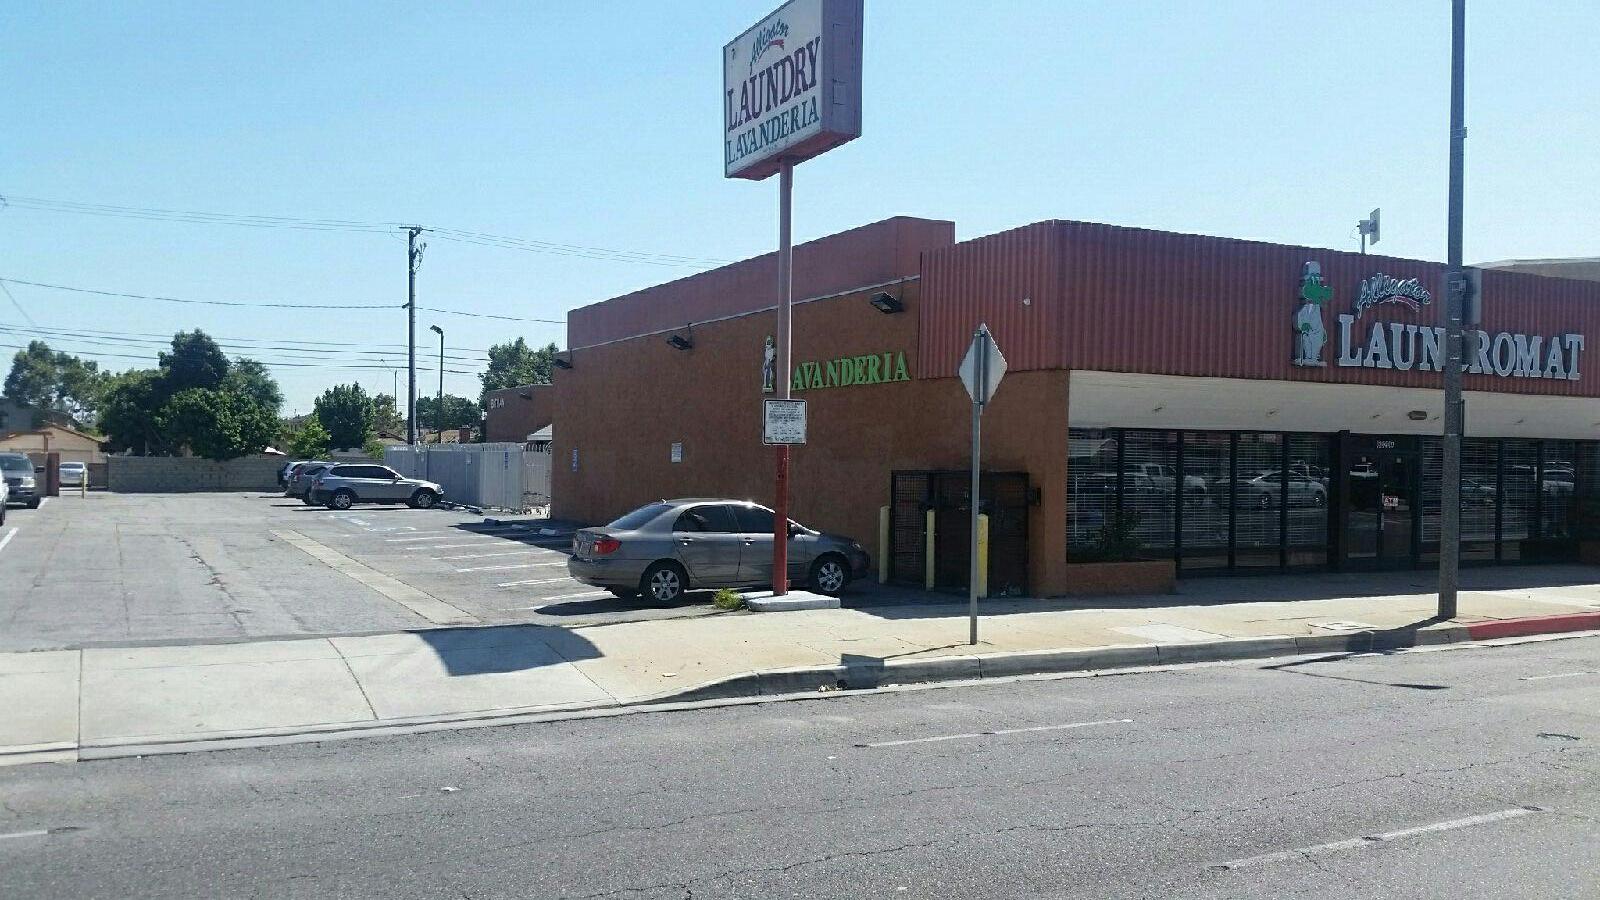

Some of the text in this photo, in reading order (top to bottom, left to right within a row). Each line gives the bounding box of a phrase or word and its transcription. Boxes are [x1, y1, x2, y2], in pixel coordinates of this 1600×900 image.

[727, 36, 821, 132] LAUNDRY
[727, 95, 820, 164] LAVANDERIA
[1356, 272, 1431, 318] Alligator
[790, 351, 911, 391] AVANDERIA
[1338, 314, 1585, 381] LAUNROMAT
